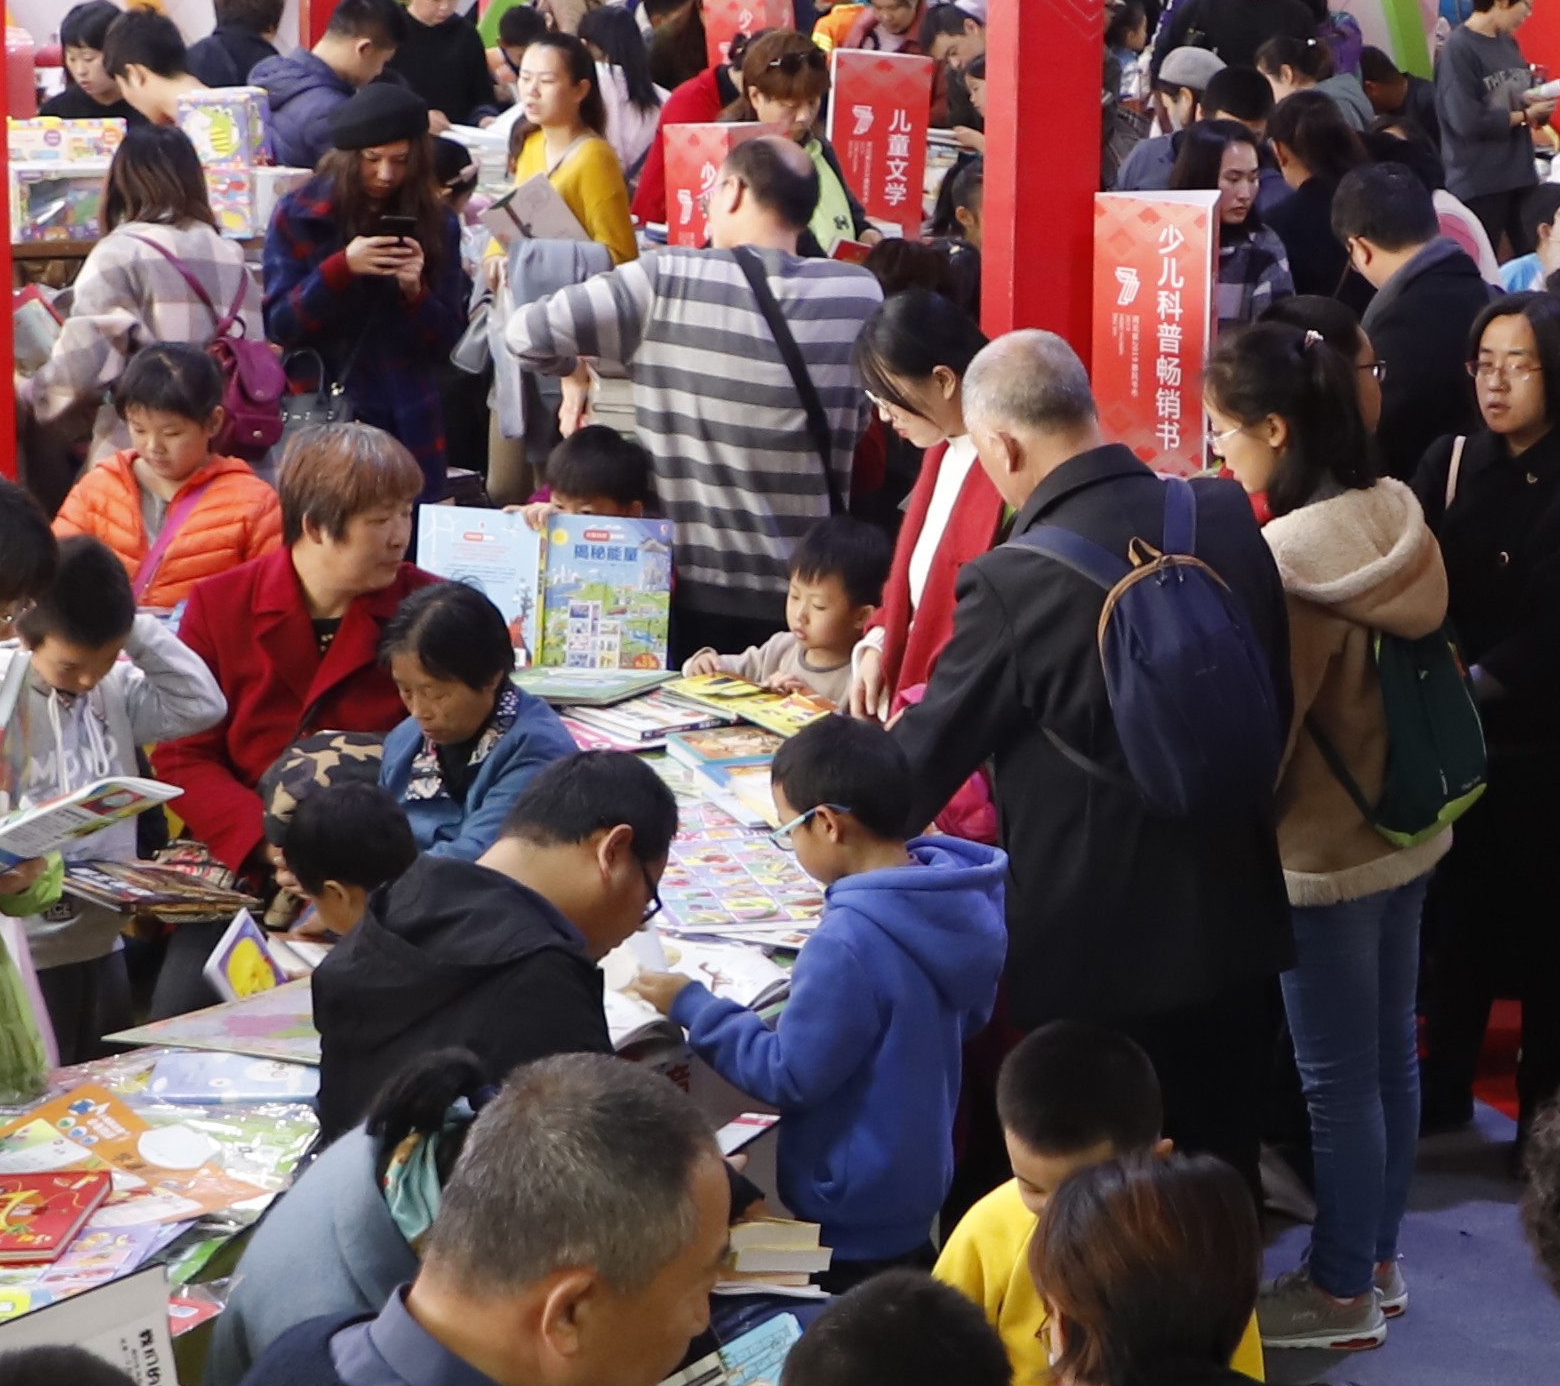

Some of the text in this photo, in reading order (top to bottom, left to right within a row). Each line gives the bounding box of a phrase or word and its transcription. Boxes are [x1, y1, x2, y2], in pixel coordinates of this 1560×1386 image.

[883, 108, 912, 206] 儿童文学
[1155, 224, 1185, 451] 少儿科普畅销书
[573, 544, 639, 563] 揭秘能量
